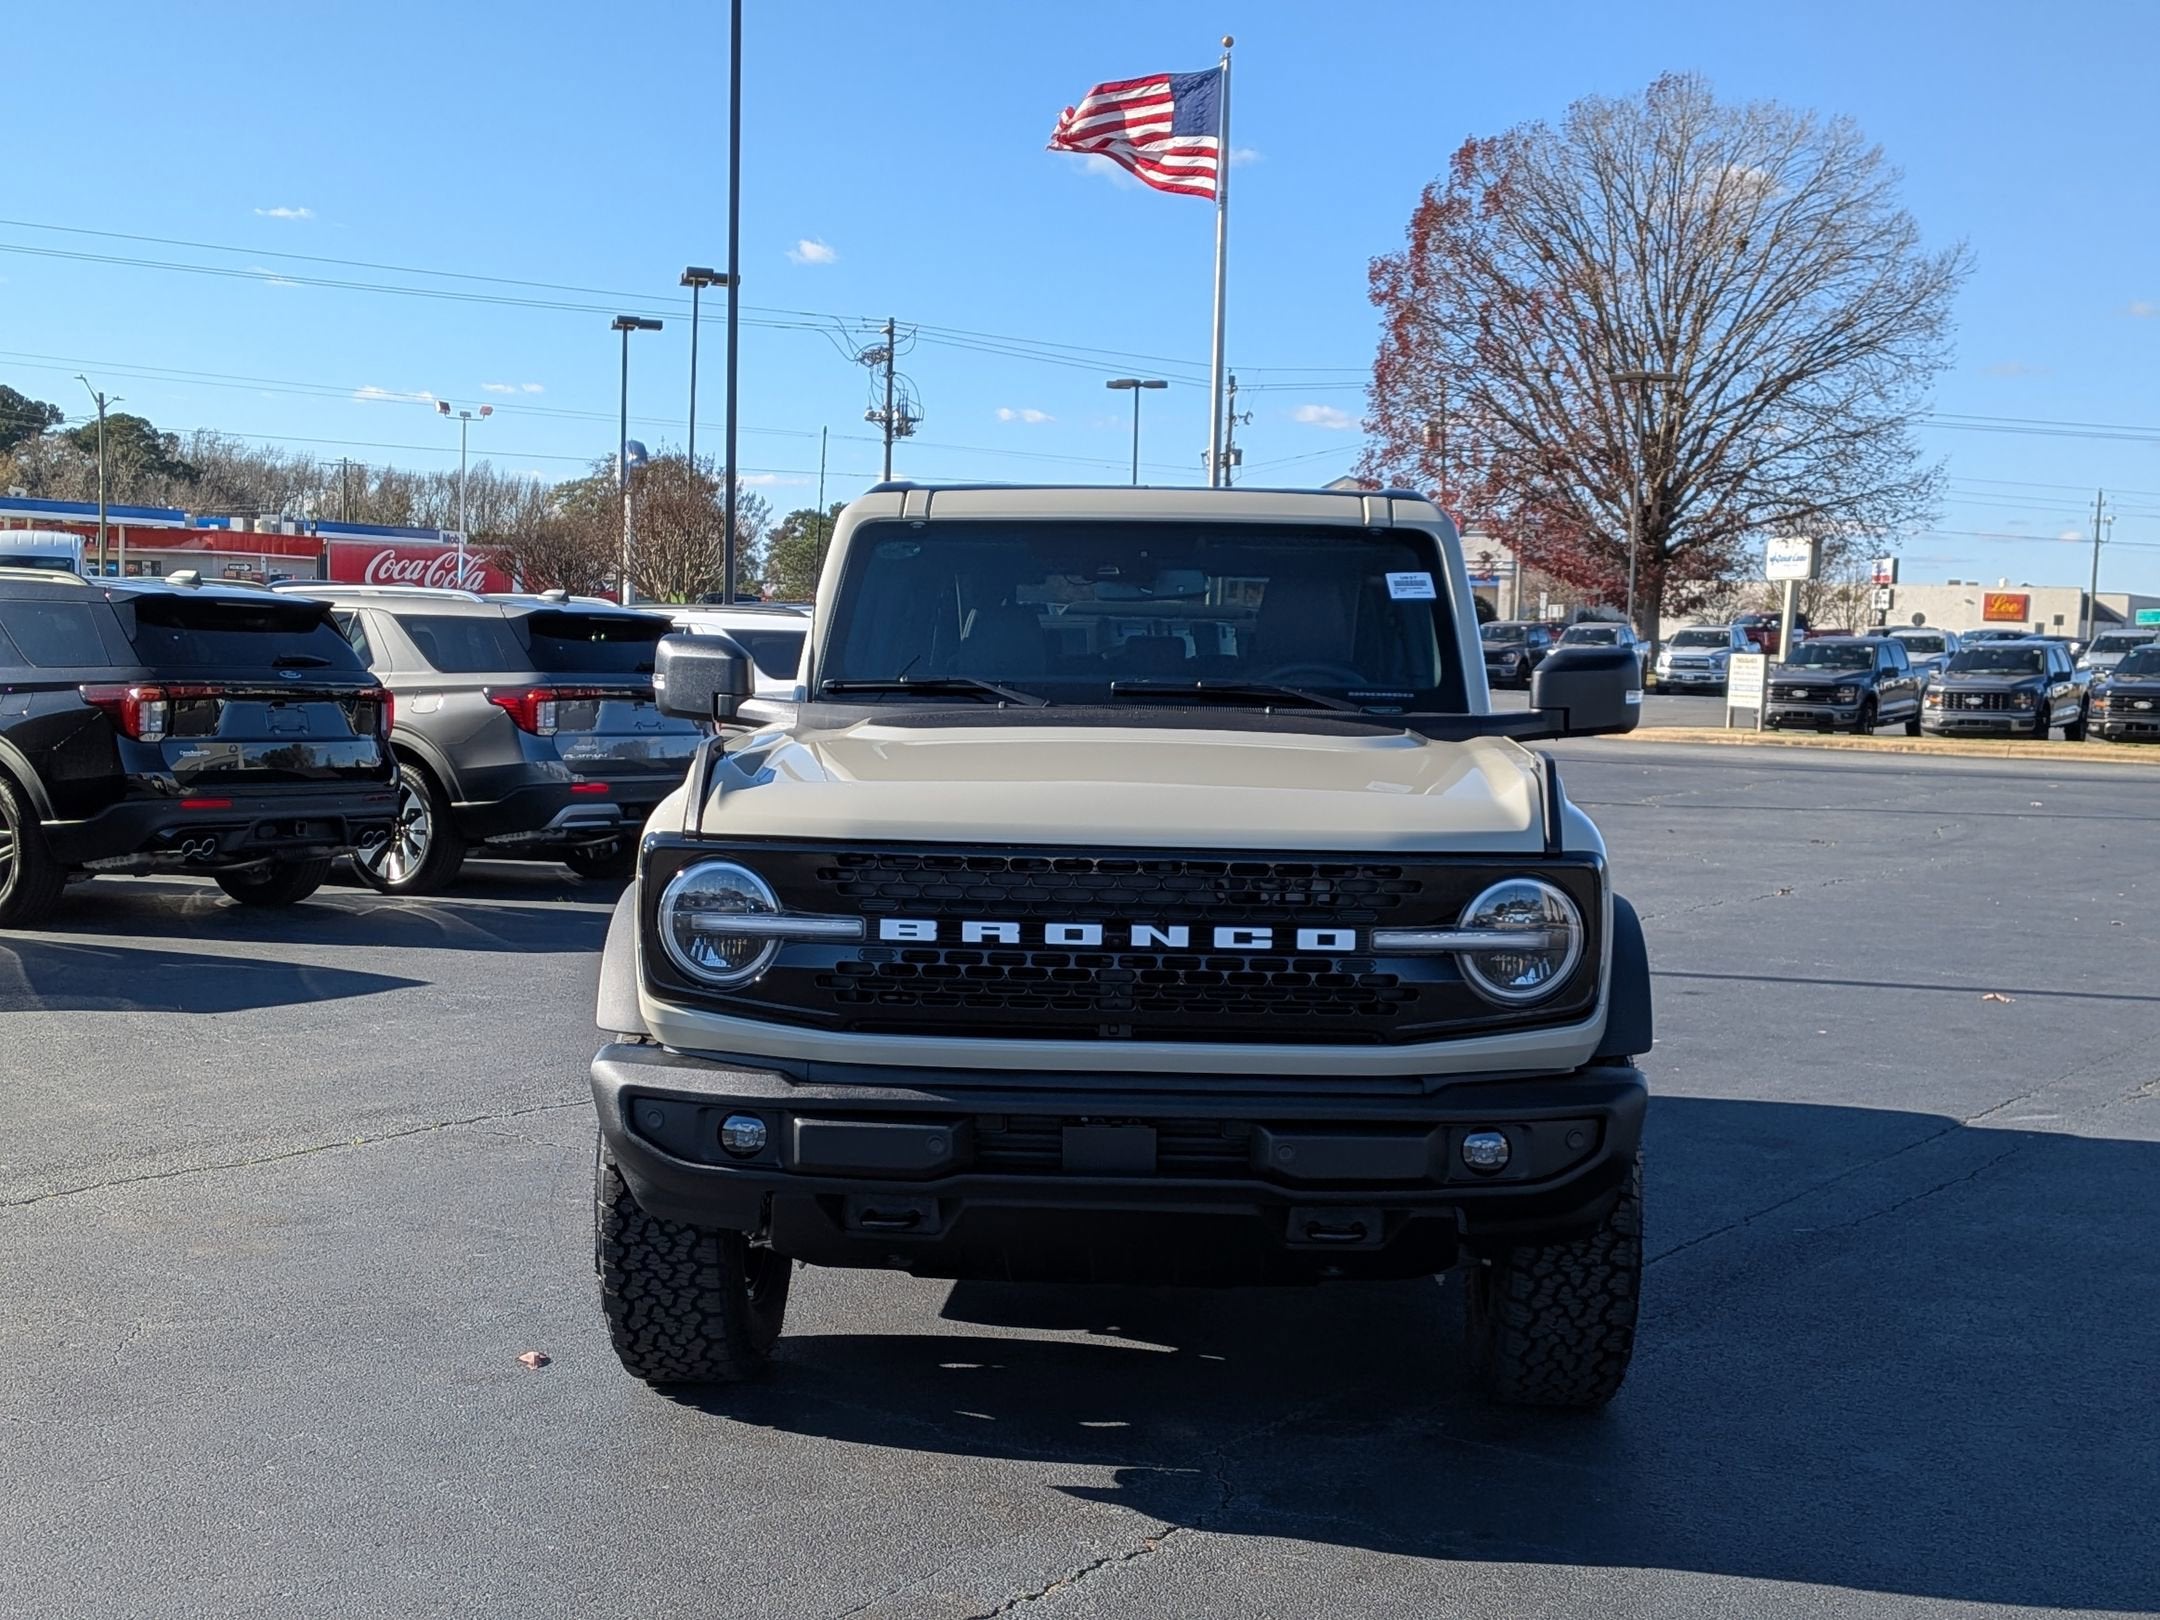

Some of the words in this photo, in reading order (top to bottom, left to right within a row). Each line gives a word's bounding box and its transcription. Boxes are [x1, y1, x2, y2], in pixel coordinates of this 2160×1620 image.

[365, 550, 488, 591] Coca-Cola
[1987, 594, 2020, 612] Lee
[880, 918, 1356, 951] BRONCO
